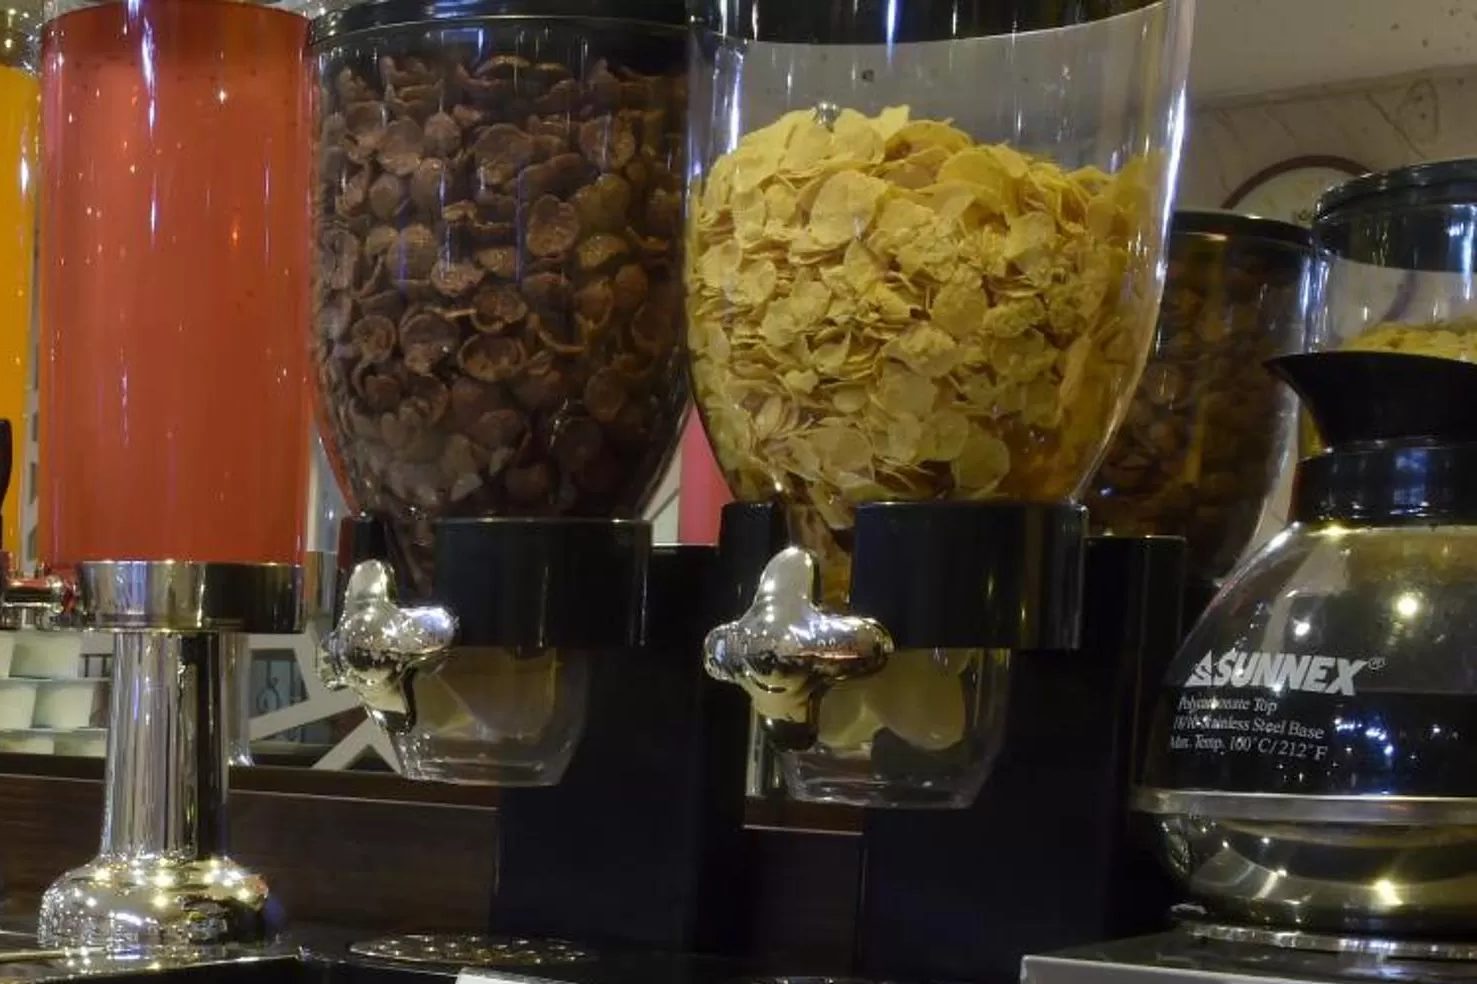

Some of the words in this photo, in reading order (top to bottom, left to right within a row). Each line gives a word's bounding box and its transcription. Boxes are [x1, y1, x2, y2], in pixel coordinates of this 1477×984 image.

[1209, 649, 1367, 696] SUNNEX
[1254, 697, 1278, 715] Top
[1252, 718, 1286, 734] Steel
[1287, 722, 1324, 740] Base
